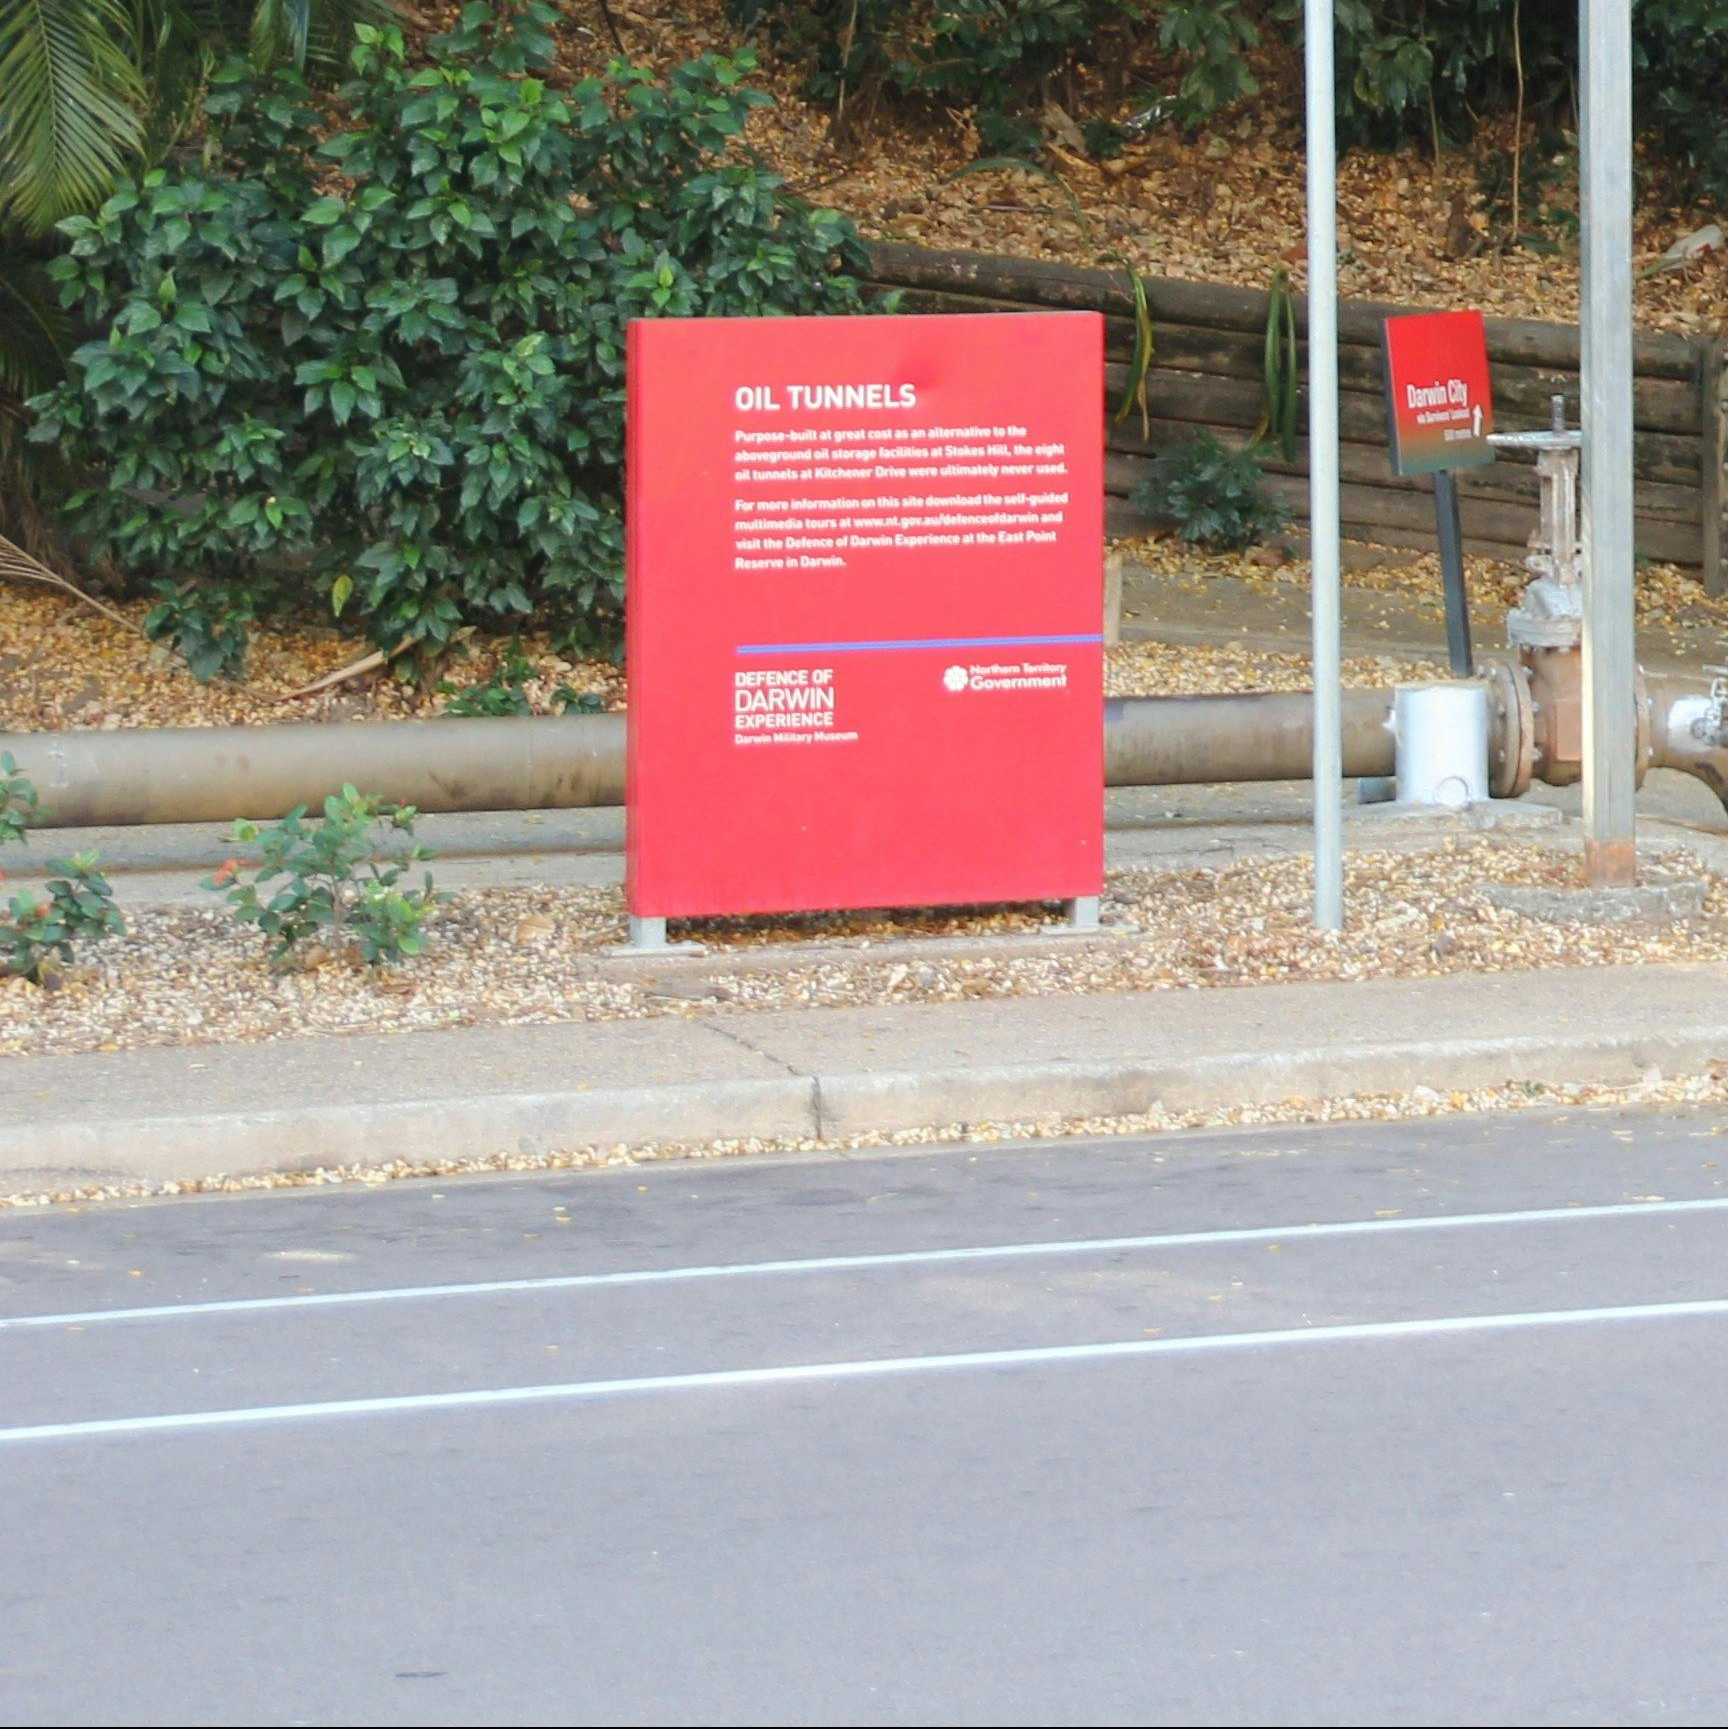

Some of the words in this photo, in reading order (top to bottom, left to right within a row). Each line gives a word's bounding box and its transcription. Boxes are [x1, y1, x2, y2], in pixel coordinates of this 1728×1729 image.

[736, 387, 780, 410] OIL
[787, 384, 916, 409] TUNNELS
[1407, 381, 1447, 409] Darwin
[1447, 379, 1468, 407] City
[735, 430, 817, 444] Purpose-built
[819, 430, 832, 440] at
[834, 430, 865, 443] great
[868, 429, 892, 440] cost
[894, 430, 909, 439] as
[910, 430, 926, 439] an
[927, 427, 991, 439] alternative
[993, 427, 1006, 437] to
[1007, 426, 1027, 436] the
[735, 449, 812, 463] aboveground
[813, 449, 829, 460] oil
[831, 449, 877, 461] storage
[879, 447, 929, 458] facilities
[930, 447, 943, 458] at
[944, 445, 985, 457] Stokes
[987, 445, 1011, 456] Hill,
[1014, 445, 1033, 455] the
[1035, 444, 1064, 457] eight
[735, 470, 750, 481] oil
[752, 469, 798, 480] tunnels
[799, 469, 813, 479] at
[815, 468, 873, 478] Kitchener
[875, 466, 906, 478] Drive
[908, 467, 938, 477] were
[940, 464, 999, 477] ultimately
[1001, 465, 1034, 474] never
[1036, 463, 1067, 474] used.
[735, 500, 755, 511] For
[757, 501, 789, 510] more
[791, 498, 860, 510] information
[860, 499, 876, 508] on
[876, 497, 900, 507] this
[902, 496, 924, 507] site
[925, 495, 982, 507] download
[982, 494, 1003, 505] the
[1004, 493, 1068, 506] self-guided
[735, 518, 803, 531] multimedia
[805, 519, 837, 529] tours
[839, 518, 851, 528] at
[1040, 512, 1063, 523] and
[736, 539, 761, 550] visit
[763, 538, 783, 549] the
[785, 537, 834, 549] Defence
[835, 536, 848, 547] of
[850, 535, 893, 547] Darwin
[894, 534, 960, 547] Experience
[962, 534, 974, 544] at
[976, 532, 996, 543] the
[998, 531, 1024, 543] East
[1026, 531, 1056, 542] Point
[735, 558, 784, 569] Reserve
[786, 557, 798, 568] in
[800, 556, 846, 568] Darwin.
[970, 665, 1020, 674] Northern
[1023, 661, 1067, 673] Territory
[735, 670, 808, 687] DEFENCE
[812, 669, 833, 684] OF
[970, 674, 1067, 690] Government
[735, 687, 833, 713] DARWIN
[735, 711, 833, 729] EXPERIENCE
[735, 734, 772, 744] Darwin
[773, 733, 813, 743] Military
[813, 732, 858, 741] Museum
